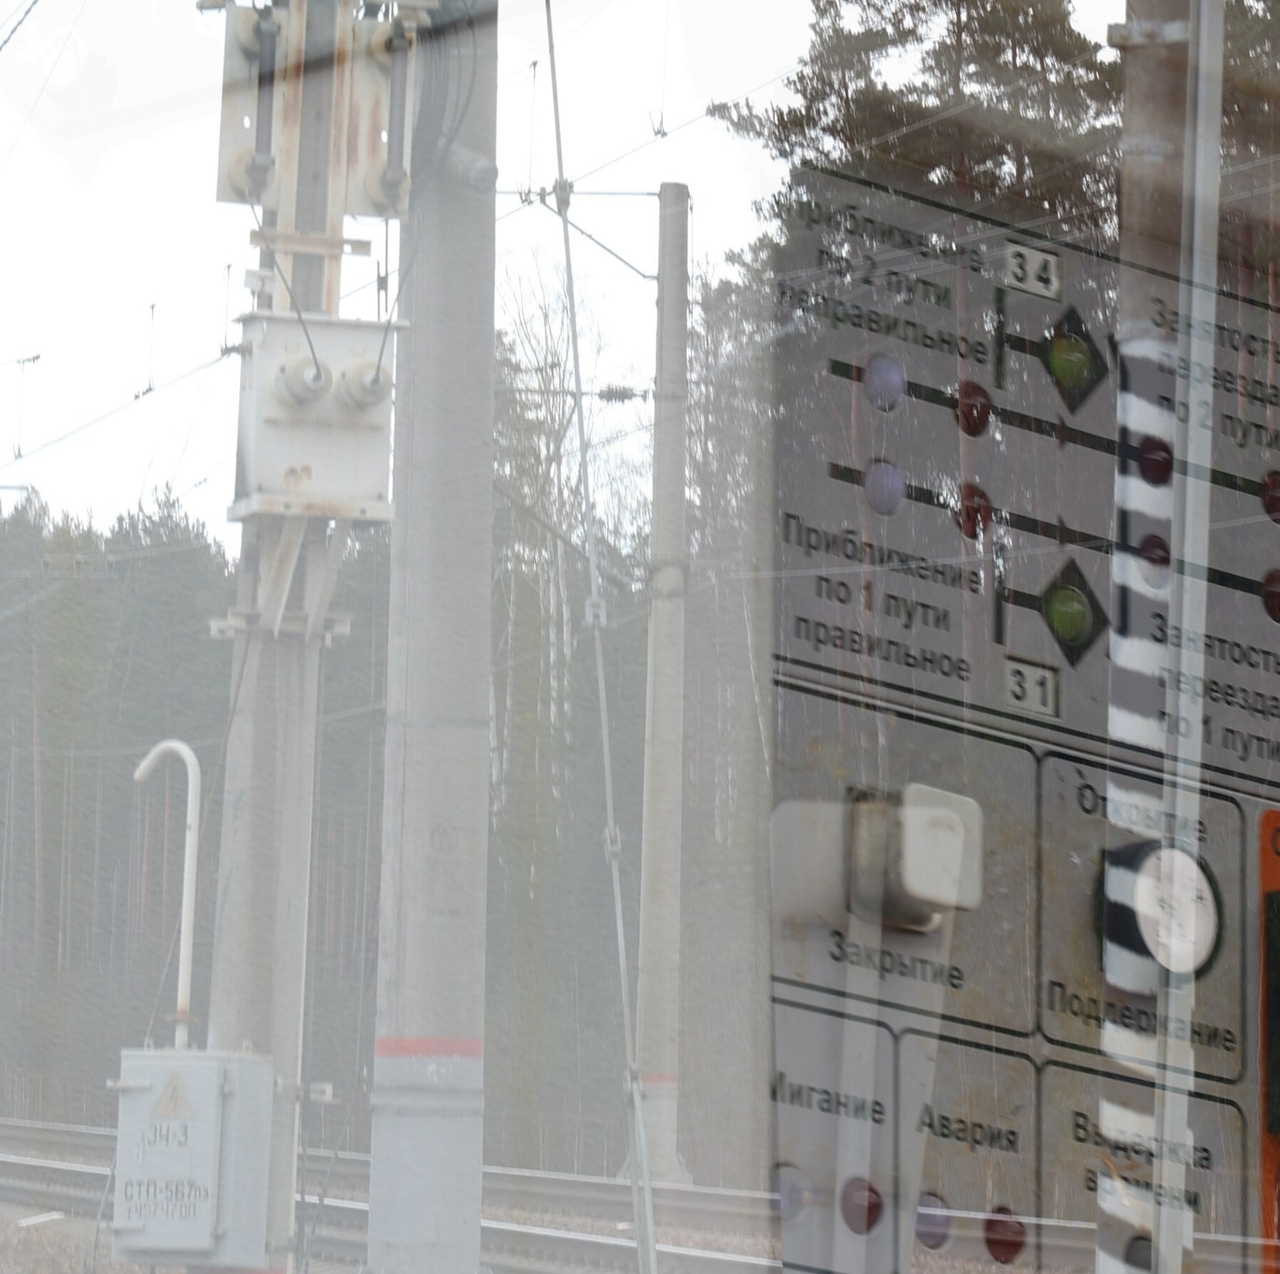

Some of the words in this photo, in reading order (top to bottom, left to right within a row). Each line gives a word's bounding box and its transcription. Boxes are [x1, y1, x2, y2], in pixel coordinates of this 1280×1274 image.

[862, 253, 878, 286] 2
[887, 268, 951, 309] пути
[1011, 251, 1052, 290] 34
[781, 513, 981, 593] Приближение
[815, 575, 852, 605] по
[861, 580, 874, 610] 1
[885, 592, 951, 634] пути
[795, 615, 972, 682] правильное
[1010, 669, 1051, 708] 31
[1079, 781, 1207, 845] Открытие
[829, 930, 965, 990] Закрытие
[1047, 979, 1238, 1055] Поддержание
[918, 1104, 1019, 1155] Авария
[1072, 1110, 1213, 1172] Выдержка
